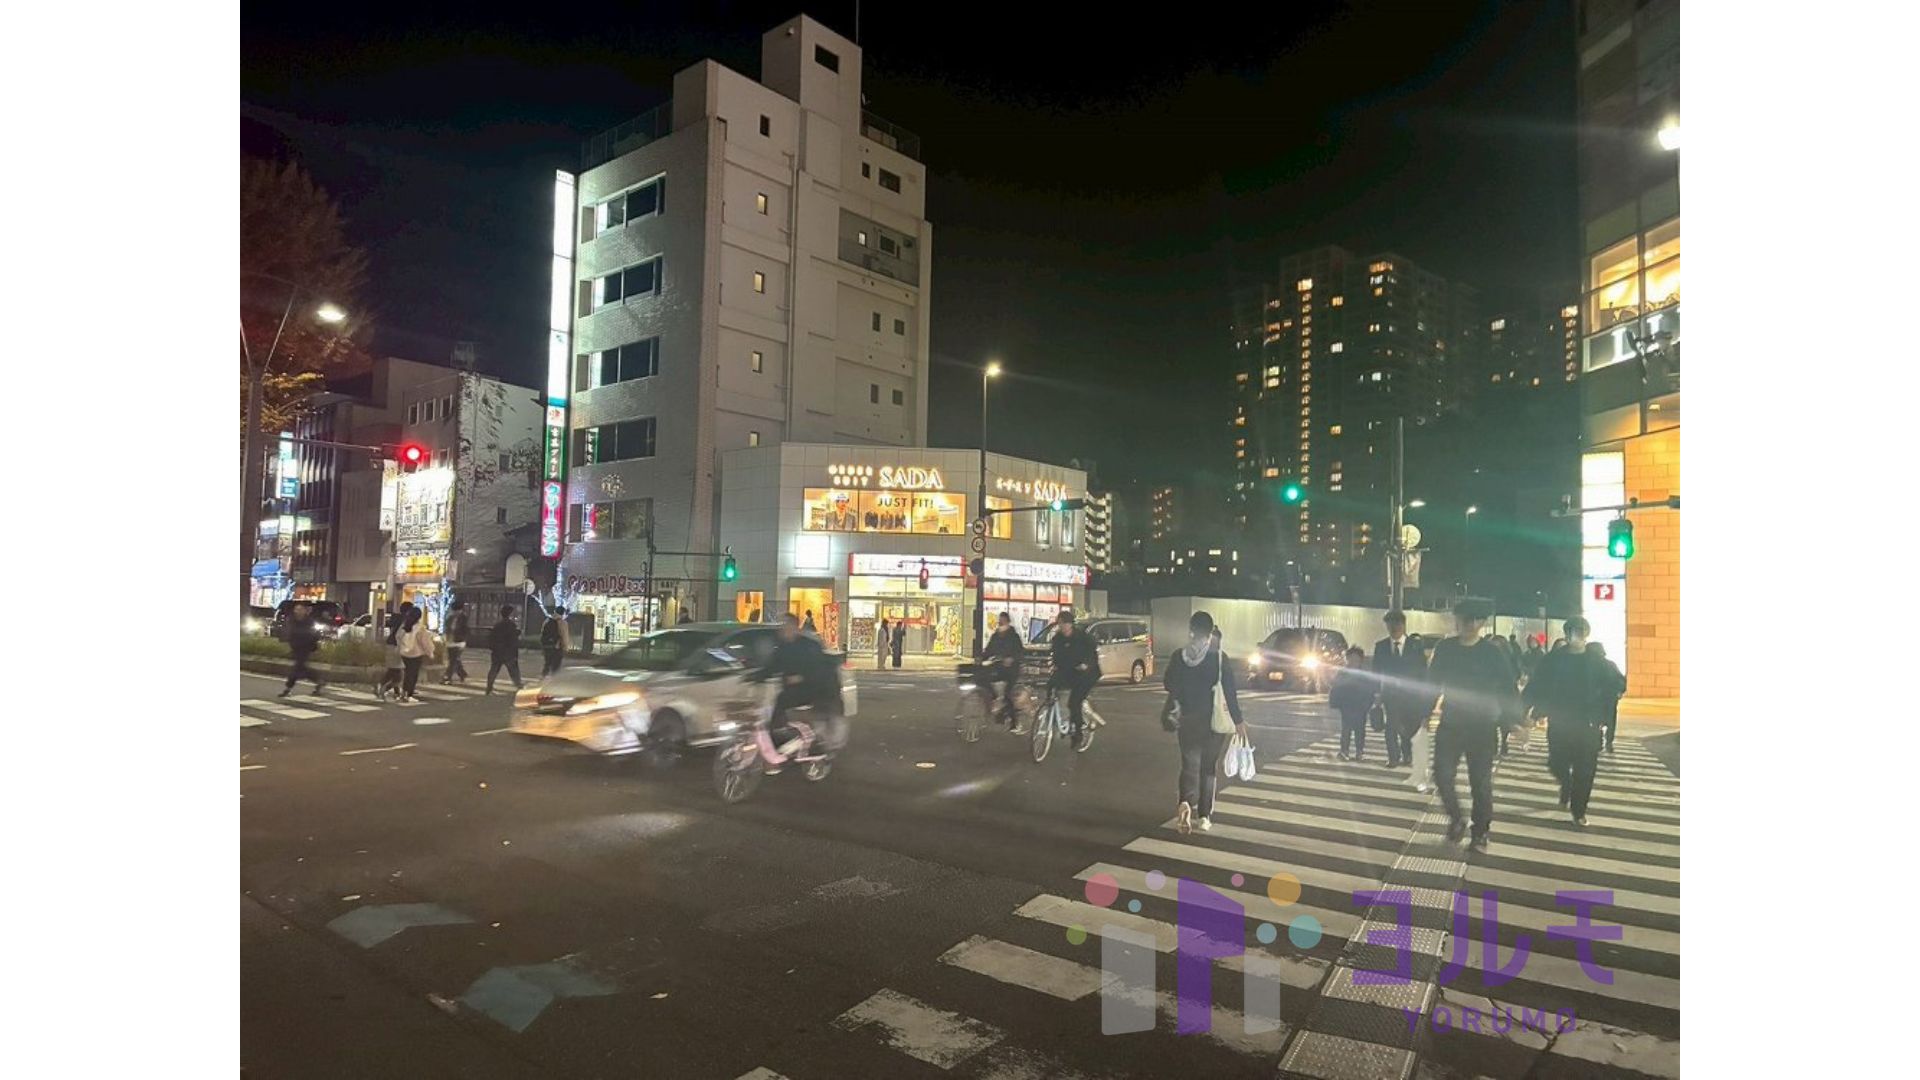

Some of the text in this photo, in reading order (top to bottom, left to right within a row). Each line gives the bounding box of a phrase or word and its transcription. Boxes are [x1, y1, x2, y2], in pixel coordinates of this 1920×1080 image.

[879, 466, 944, 489] SADA
[1034, 479, 1067, 501] SADA
[877, 497, 934, 508] JUST FIT!
[542, 482, 561, 556] クリーニング
